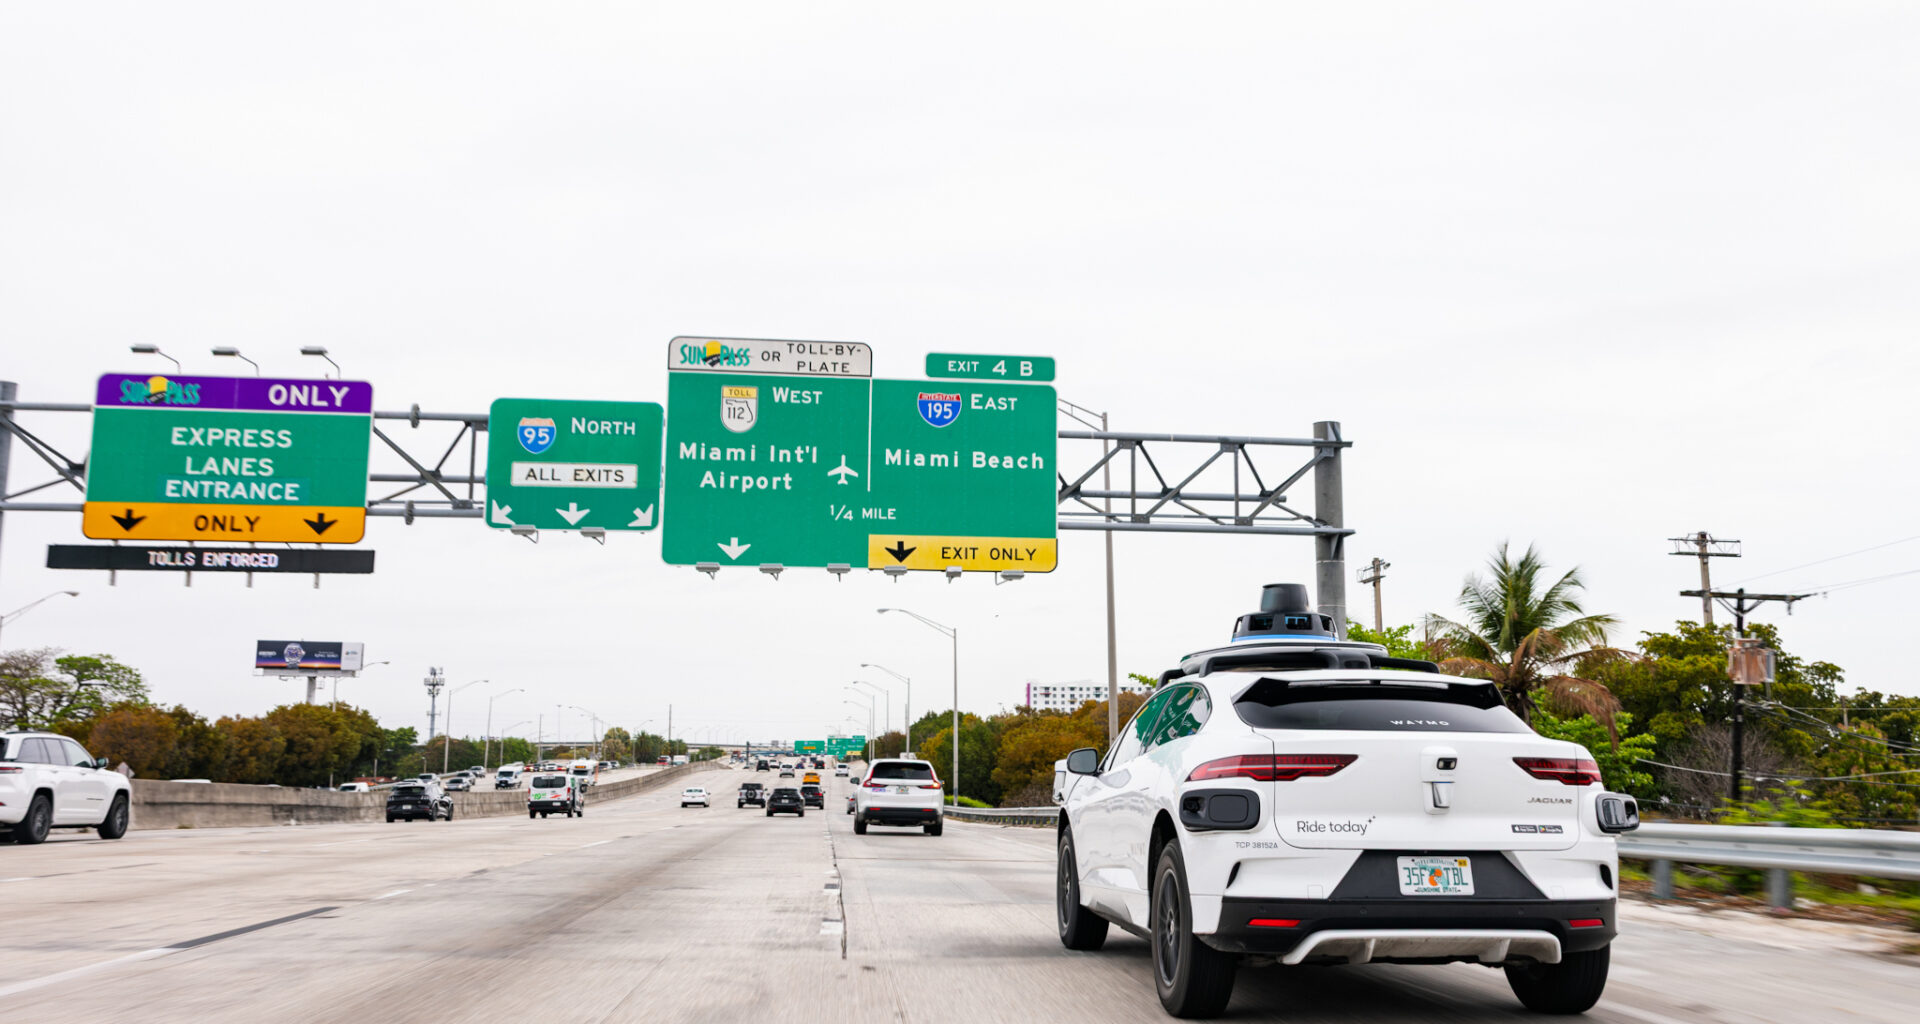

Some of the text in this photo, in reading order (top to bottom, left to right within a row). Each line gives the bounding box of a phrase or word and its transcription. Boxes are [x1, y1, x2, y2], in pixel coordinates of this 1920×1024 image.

[760, 351, 781, 362] OR
[796, 361, 851, 373] PLATE
[947, 360, 1034, 376] EXIT 4 B
[267, 384, 351, 408] ONLY
[728, 388, 752, 397] TOLL
[771, 387, 823, 404] WEST
[927, 402, 953, 420] 195
[970, 394, 1018, 411] EAST
[727, 406, 745, 420] 112
[571, 417, 636, 435] NORTH
[170, 427, 293, 449] EXPRESS
[523, 428, 550, 445] 95
[679, 442, 757, 462] Miami
[885, 448, 1045, 470] Miami Beach
[185, 456, 274, 477] LANES
[525, 468, 625, 483] ALL EXITS
[699, 470, 793, 493] Airport
[165, 479, 300, 501] ENTRANCE
[861, 507, 897, 520] MILE
[193, 514, 261, 533] ONLY
[147, 551, 279, 568] TOLLS ENFORCED
[941, 546, 1037, 561] EXIT ONLY
[1296, 820, 1368, 836] Ride today
